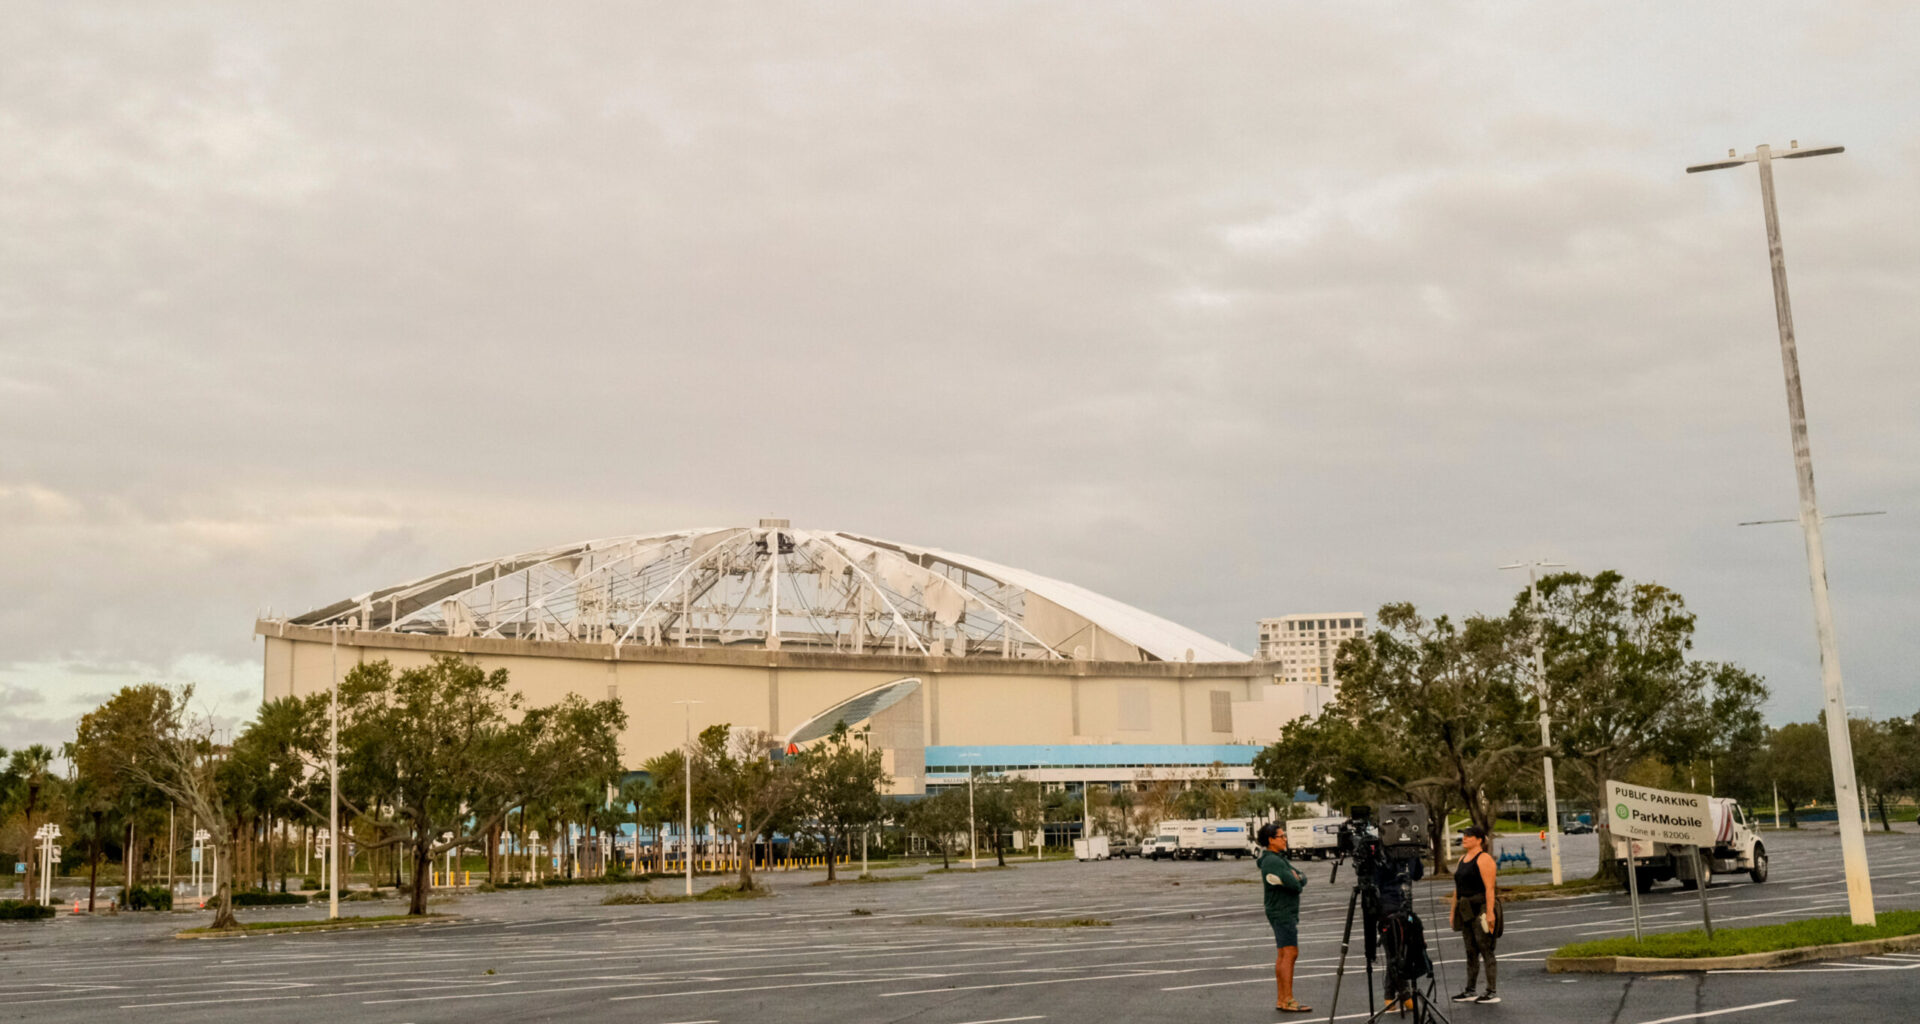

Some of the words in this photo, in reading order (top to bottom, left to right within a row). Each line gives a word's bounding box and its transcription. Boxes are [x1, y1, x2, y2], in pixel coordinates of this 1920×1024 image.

[1615, 787, 1648, 802] PUBLIC
[1650, 794, 1698, 808] PARKING
[1632, 809, 1702, 828] ParkMobile
[1630, 826, 1649, 837] Zone
[1663, 830, 1690, 840] 82006
